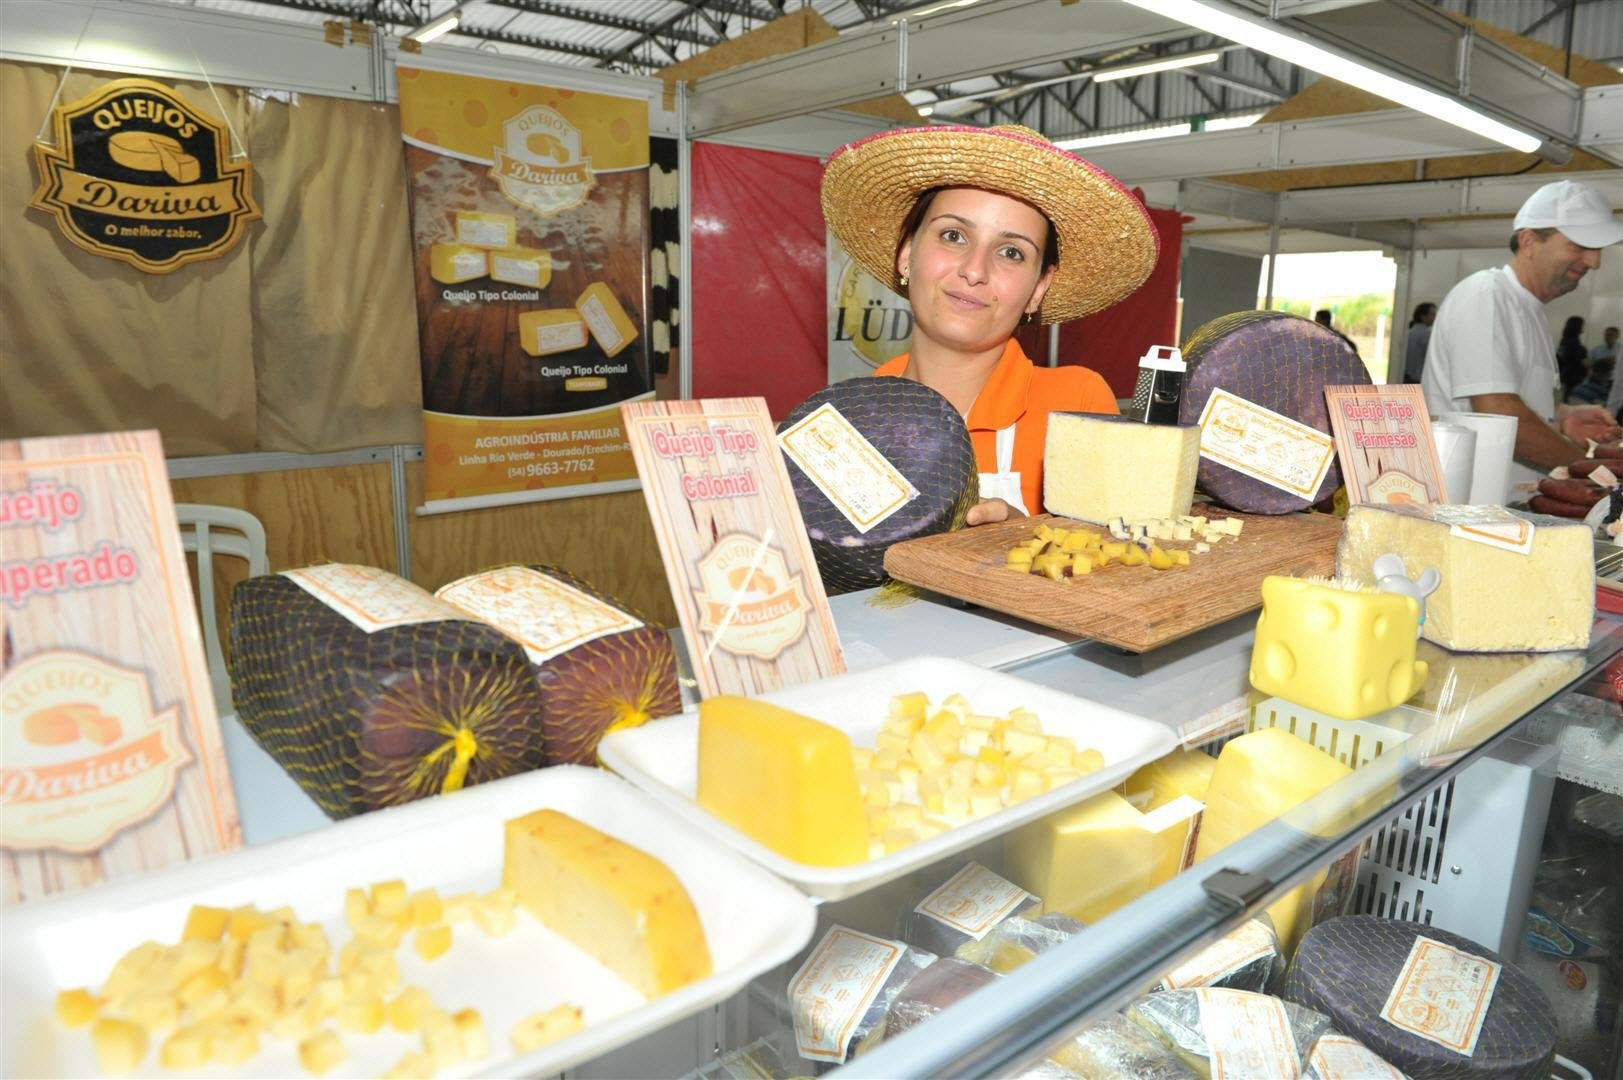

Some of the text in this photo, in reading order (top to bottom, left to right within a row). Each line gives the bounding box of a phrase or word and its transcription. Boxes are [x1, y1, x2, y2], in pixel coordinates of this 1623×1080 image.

[93, 98, 199, 138] QUEIJOS
[518, 112, 570, 137] QUEIJOS
[509, 162, 580, 184] Dariva
[78, 180, 221, 215] Dariva
[105, 224, 202, 239] O melhor sabor.
[443, 290, 539, 303] Queijo Tipo Colonial
[541, 363, 628, 378] Queijo Tipo Colonial
[1344, 401, 1413, 423] Queijo Tipo
[475, 427, 621, 449] AGROINDÚSTRIA FAMILIAR
[654, 428, 757, 459] Queijo Tipo
[1355, 429, 1416, 447] Parmesão
[459, 454, 487, 466] Linha
[489, 454, 505, 464] Rio
[507, 451, 535, 462] Verde
[508, 458, 595, 479] (54) 9663-7762
[682, 469, 757, 498] Colonial
[0, 484, 80, 528] ueijo
[0, 544, 137, 602] perado
[0, 751, 149, 801] Dariva
